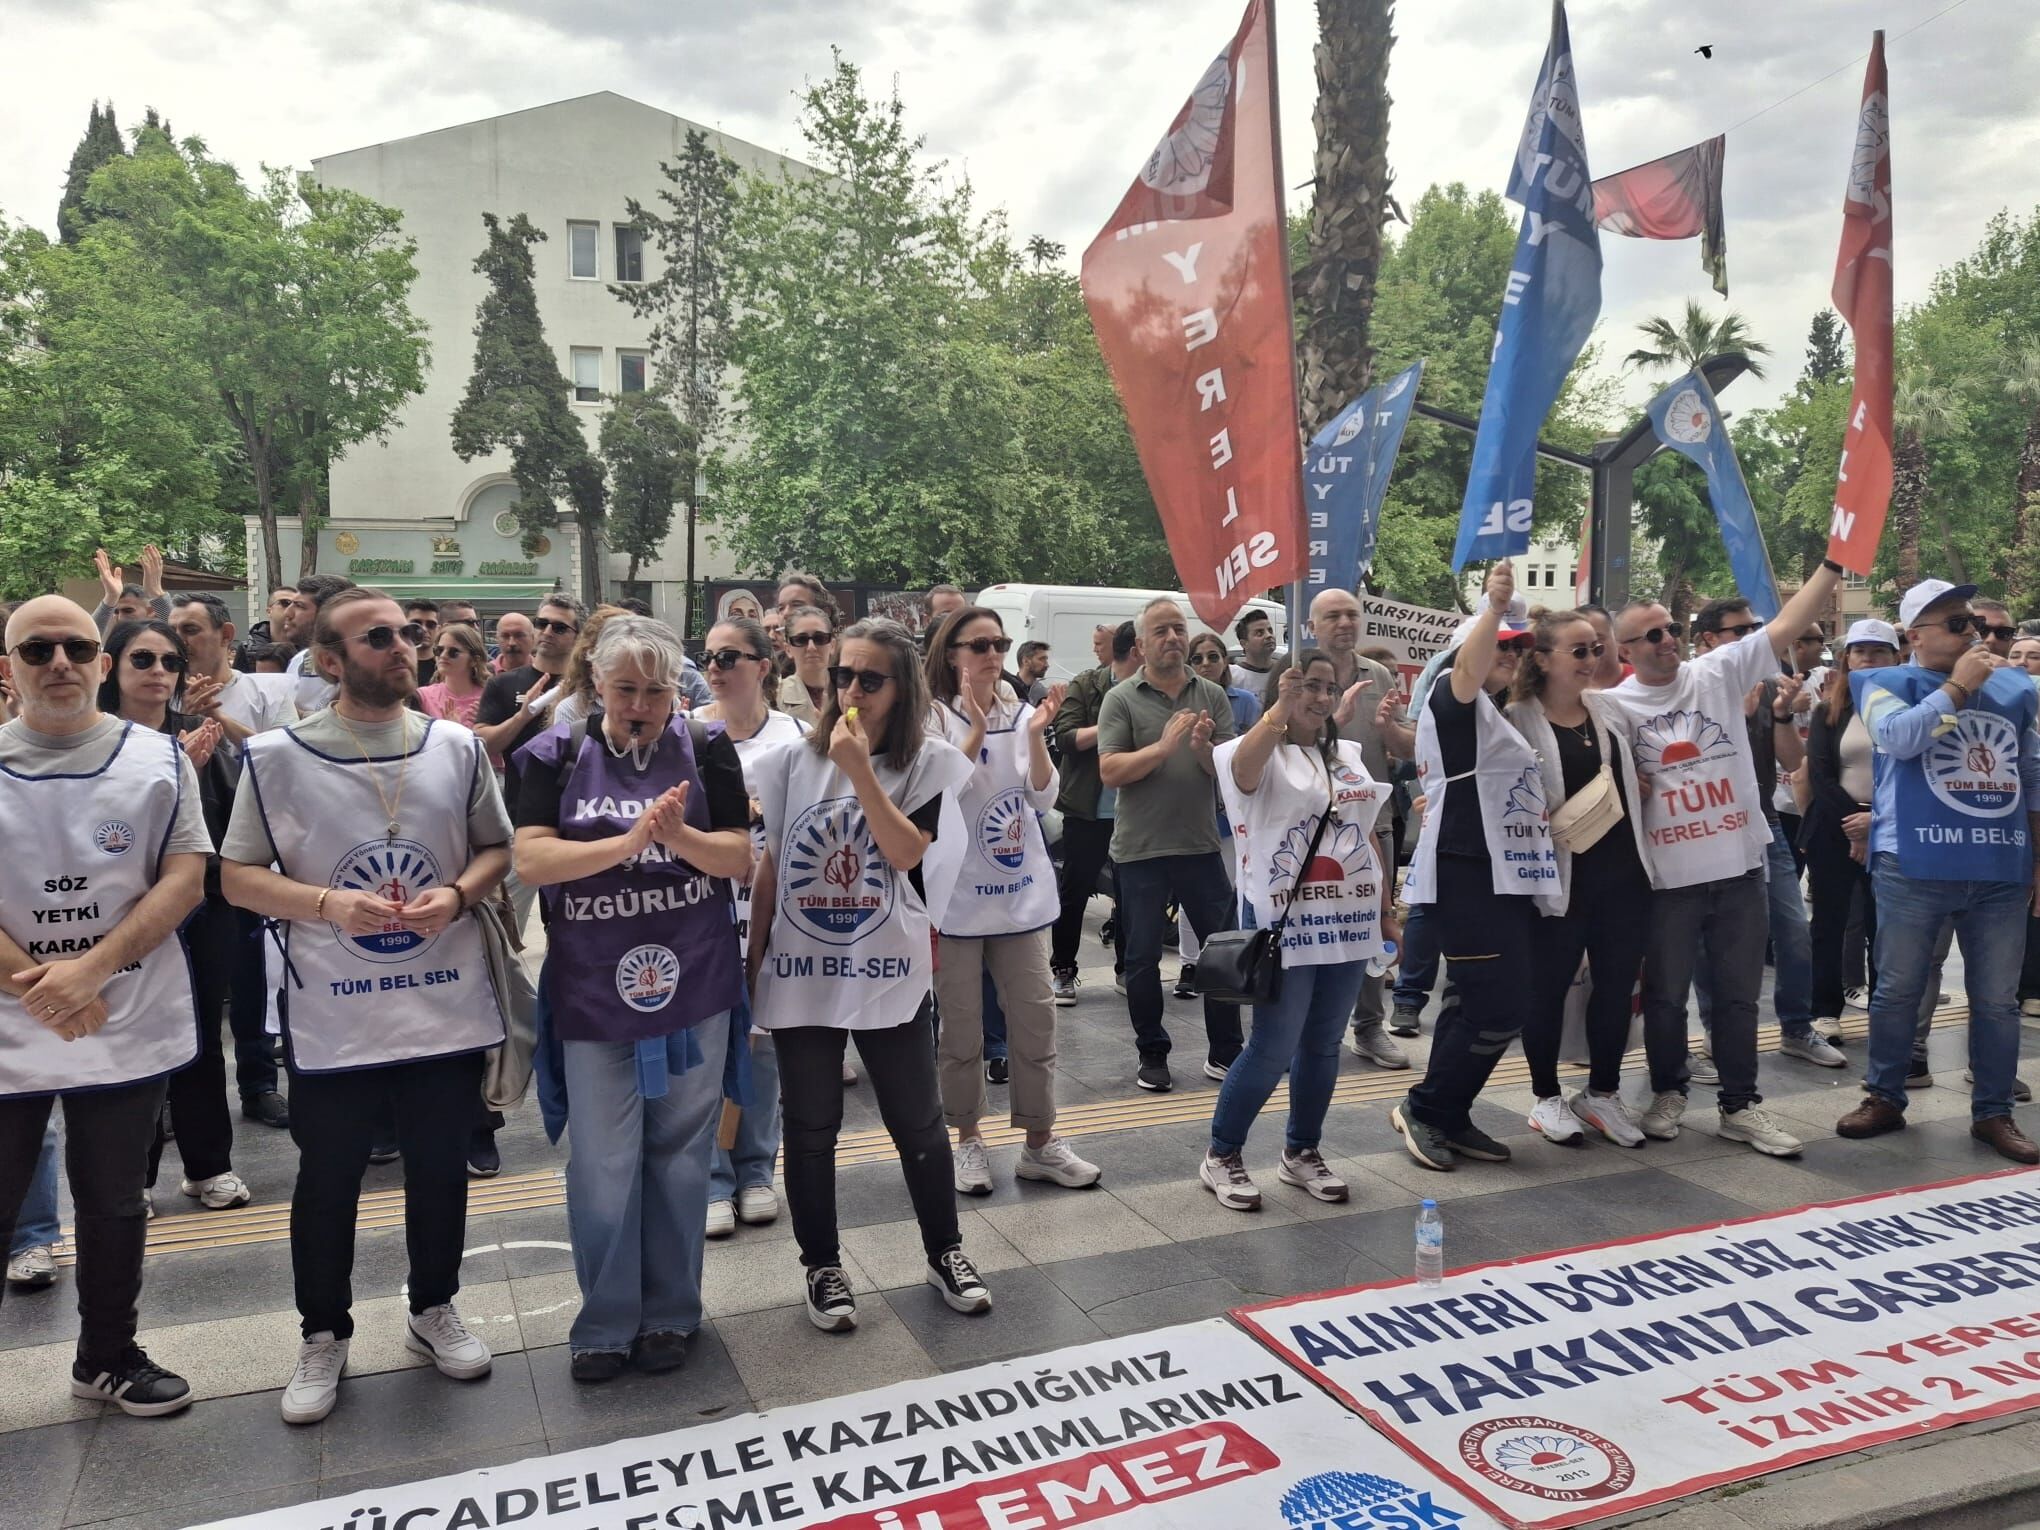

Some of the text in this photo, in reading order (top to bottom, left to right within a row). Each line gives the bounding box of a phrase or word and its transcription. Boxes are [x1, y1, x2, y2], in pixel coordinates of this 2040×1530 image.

[1363, 601, 1460, 629] KARŞIYAKA
[1661, 778, 1735, 817] TÜM
[1943, 779, 1974, 790] TÜM
[1648, 809, 1749, 846] YEREL-SEN
[1914, 824, 1964, 844] TÜM
[44, 875, 88, 893] SÖZ
[975, 883, 1005, 896] TÜM
[564, 876, 715, 921] ÖZGÜRLÜK
[797, 894, 828, 908] TÜM
[32, 902, 100, 924] YETKİ
[379, 935, 410, 947] 1990
[1338, 928, 1370, 943] Mevzi
[822, 957, 911, 978] BEL-SEN
[330, 968, 460, 996] TÜM BEL SEN
[1289, 1278, 1550, 1367] ALINTERİ
[1525, 1254, 1736, 1313] DÖKEN
[1704, 1235, 1838, 1279] BİZ,
[1796, 1214, 1954, 1260] EMEK
[1363, 1242, 2040, 1425] HAKKIMIZI GASBED
[1661, 1312, 2040, 1415] TÜM YERE
[782, 1350, 1189, 1462] KAZANDIĞIMIZ
[1718, 1386, 1933, 1449] İZMİR
[1922, 1376, 1985, 1401] 2
[812, 1373, 1304, 1511] KAZANIMLARIMIZ
[1484, 1417, 1601, 1442] ÇALIŞANLARI
[1463, 1427, 1488, 1468] YÖNETİM
[1555, 1469, 1590, 1483] 2013
[1599, 1442, 1635, 1490] SENDİKASI
[1481, 1467, 1538, 1494] YEREL
